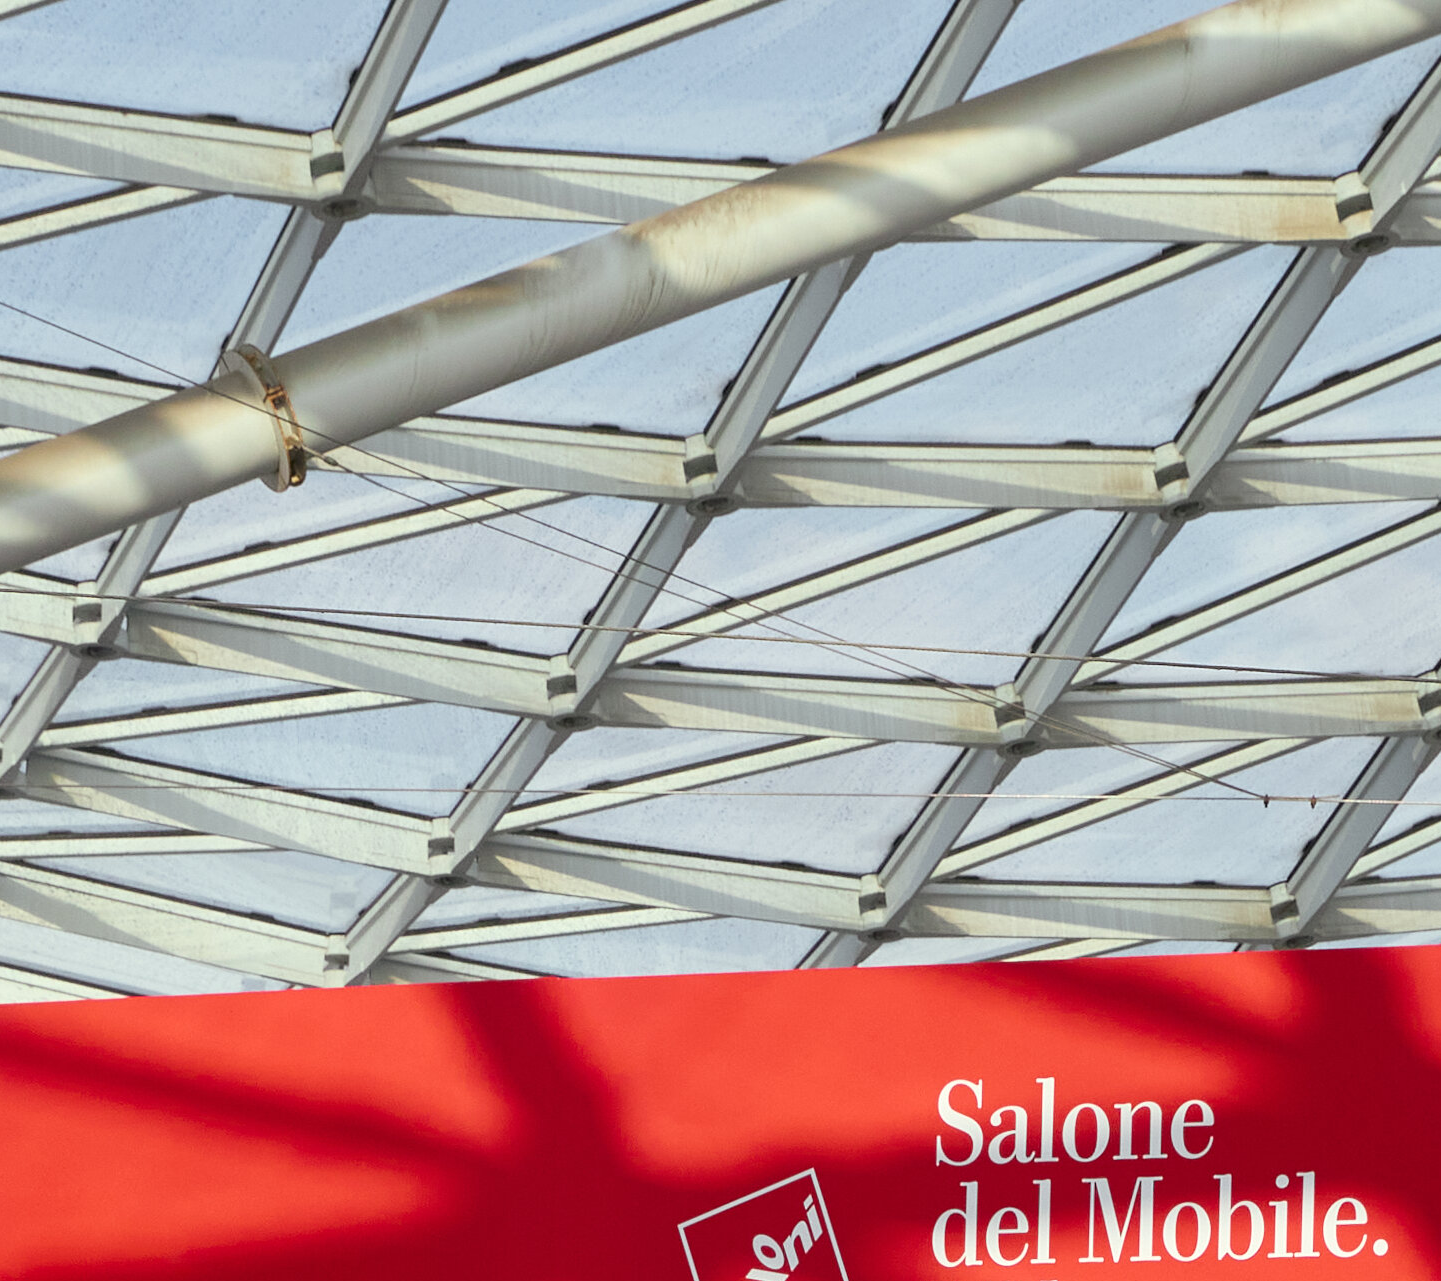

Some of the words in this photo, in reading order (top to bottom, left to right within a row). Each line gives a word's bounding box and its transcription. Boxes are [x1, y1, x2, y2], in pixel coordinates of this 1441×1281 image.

[935, 1077, 1215, 1168] Salone
[929, 1179, 1053, 1268] del
[1079, 1171, 1391, 1265] Mobile.
